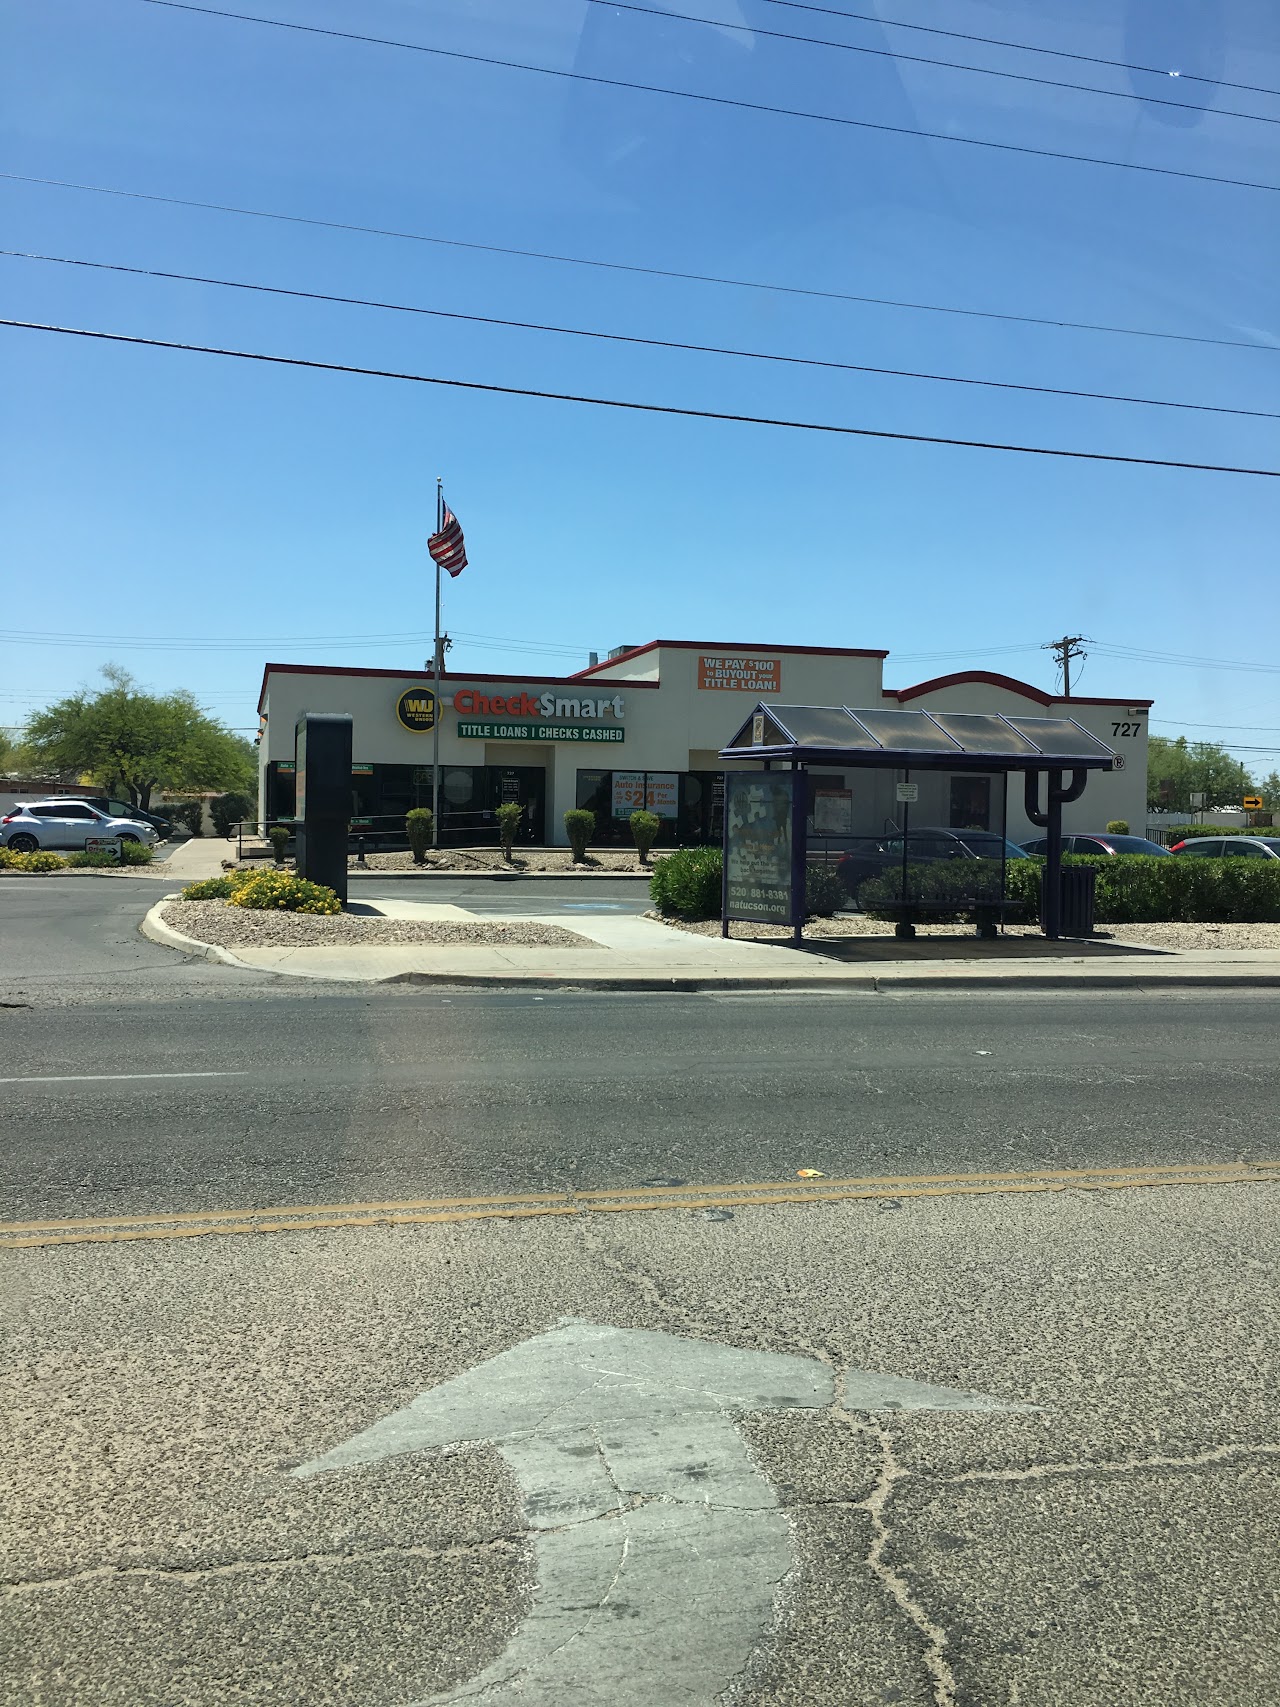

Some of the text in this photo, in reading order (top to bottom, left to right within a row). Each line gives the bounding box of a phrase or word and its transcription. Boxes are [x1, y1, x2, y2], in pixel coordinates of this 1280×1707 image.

[703, 658, 774, 671] WE PAY $100
[715, 669, 758, 680] BUYOUT
[703, 678, 777, 690] TITLE LOAN!
[460, 724, 491, 737] TITLE
[493, 725, 528, 738] LOANS
[538, 727, 579, 739] CHECKS
[582, 728, 623, 741] CASHED
[1111, 722, 1142, 737] 727
[614, 780, 675, 790] Auto Insurance
[624, 790, 656, 807] $24
[750, 888, 789, 901] 881-8381
[729, 900, 786, 915] natucson.org
